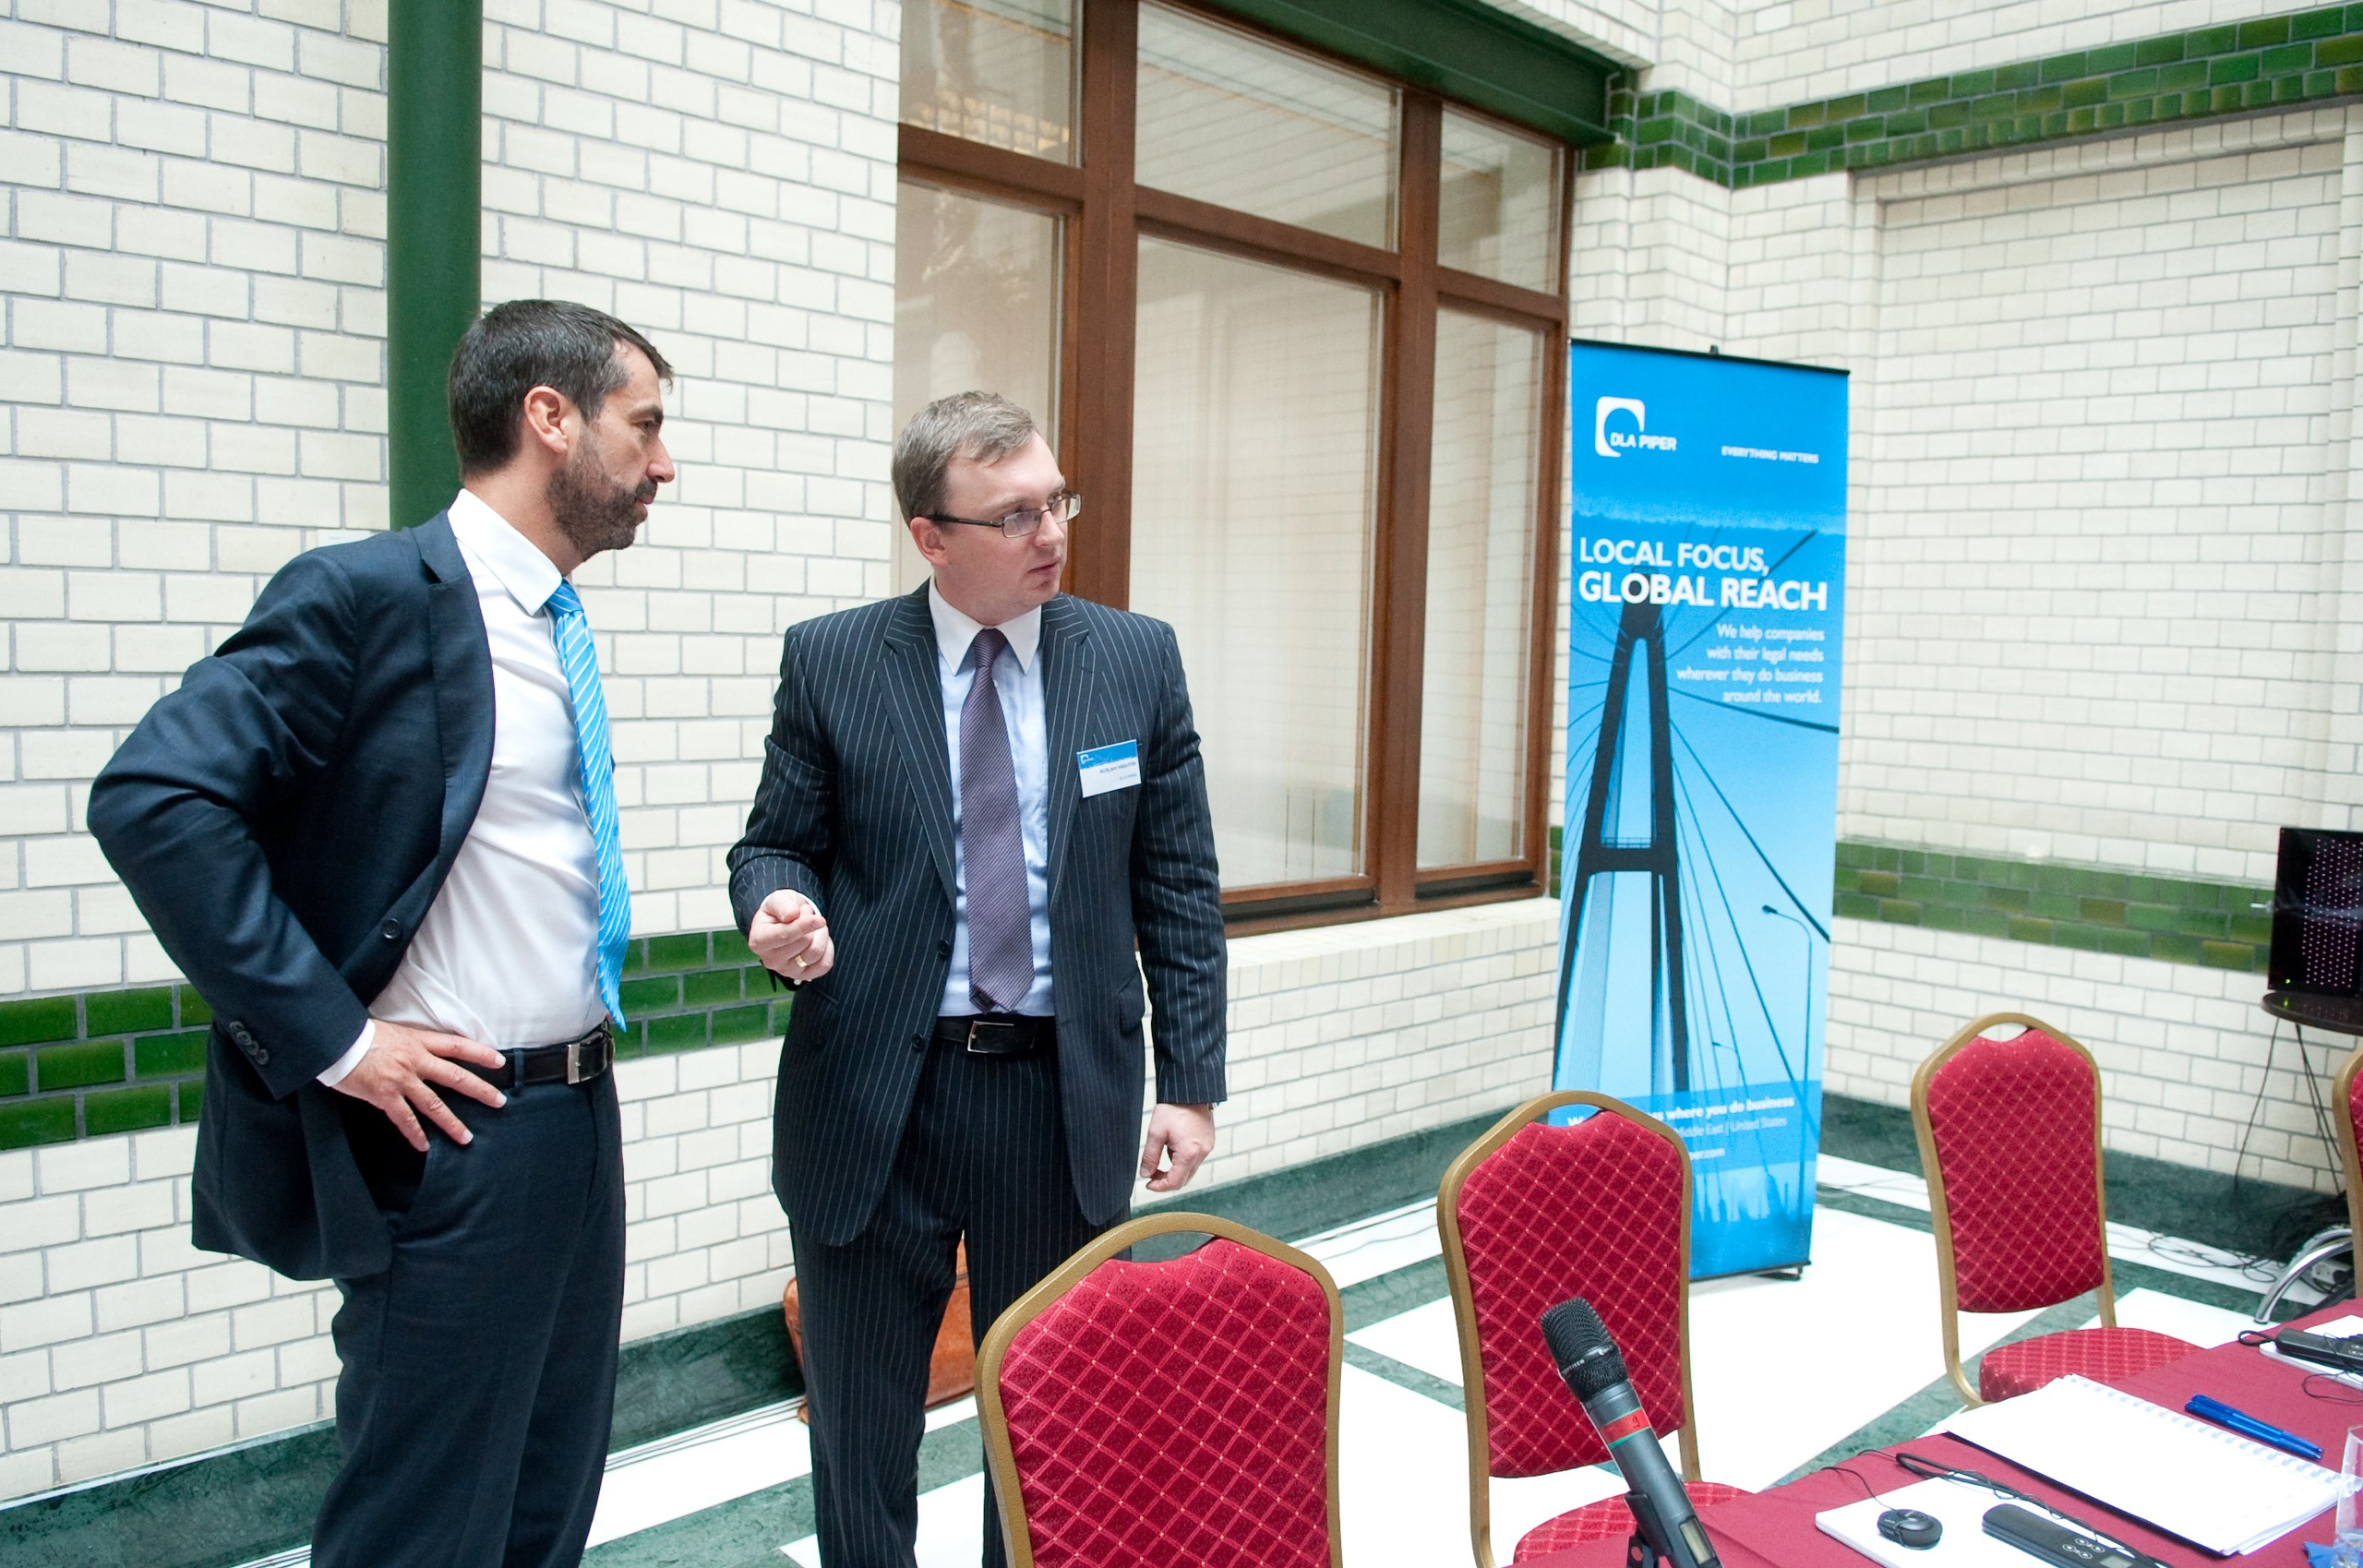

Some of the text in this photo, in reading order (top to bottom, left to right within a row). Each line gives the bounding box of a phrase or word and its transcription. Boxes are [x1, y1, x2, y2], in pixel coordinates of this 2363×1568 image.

[1611, 432, 1677, 451] DLA PIPER
[1721, 445, 1819, 464] EVERYTHING MATTERS
[1579, 537, 1769, 577] LOCAL FOCUS,
[1578, 570, 1828, 611] GLOBAL REACH
[1717, 624, 1825, 644] We help companies
[1708, 646, 1825, 665] with their legal needs
[1676, 666, 1824, 685] wherever they do business
[1722, 688, 1823, 704] around the world.
[1665, 1107, 1704, 1119] where
[1706, 1106, 1728, 1120] you
[1729, 1099, 1745, 1114] do
[1746, 1095, 1795, 1112] business
[1729, 1118, 1760, 1133] United
[1760, 1116, 1788, 1129] States
